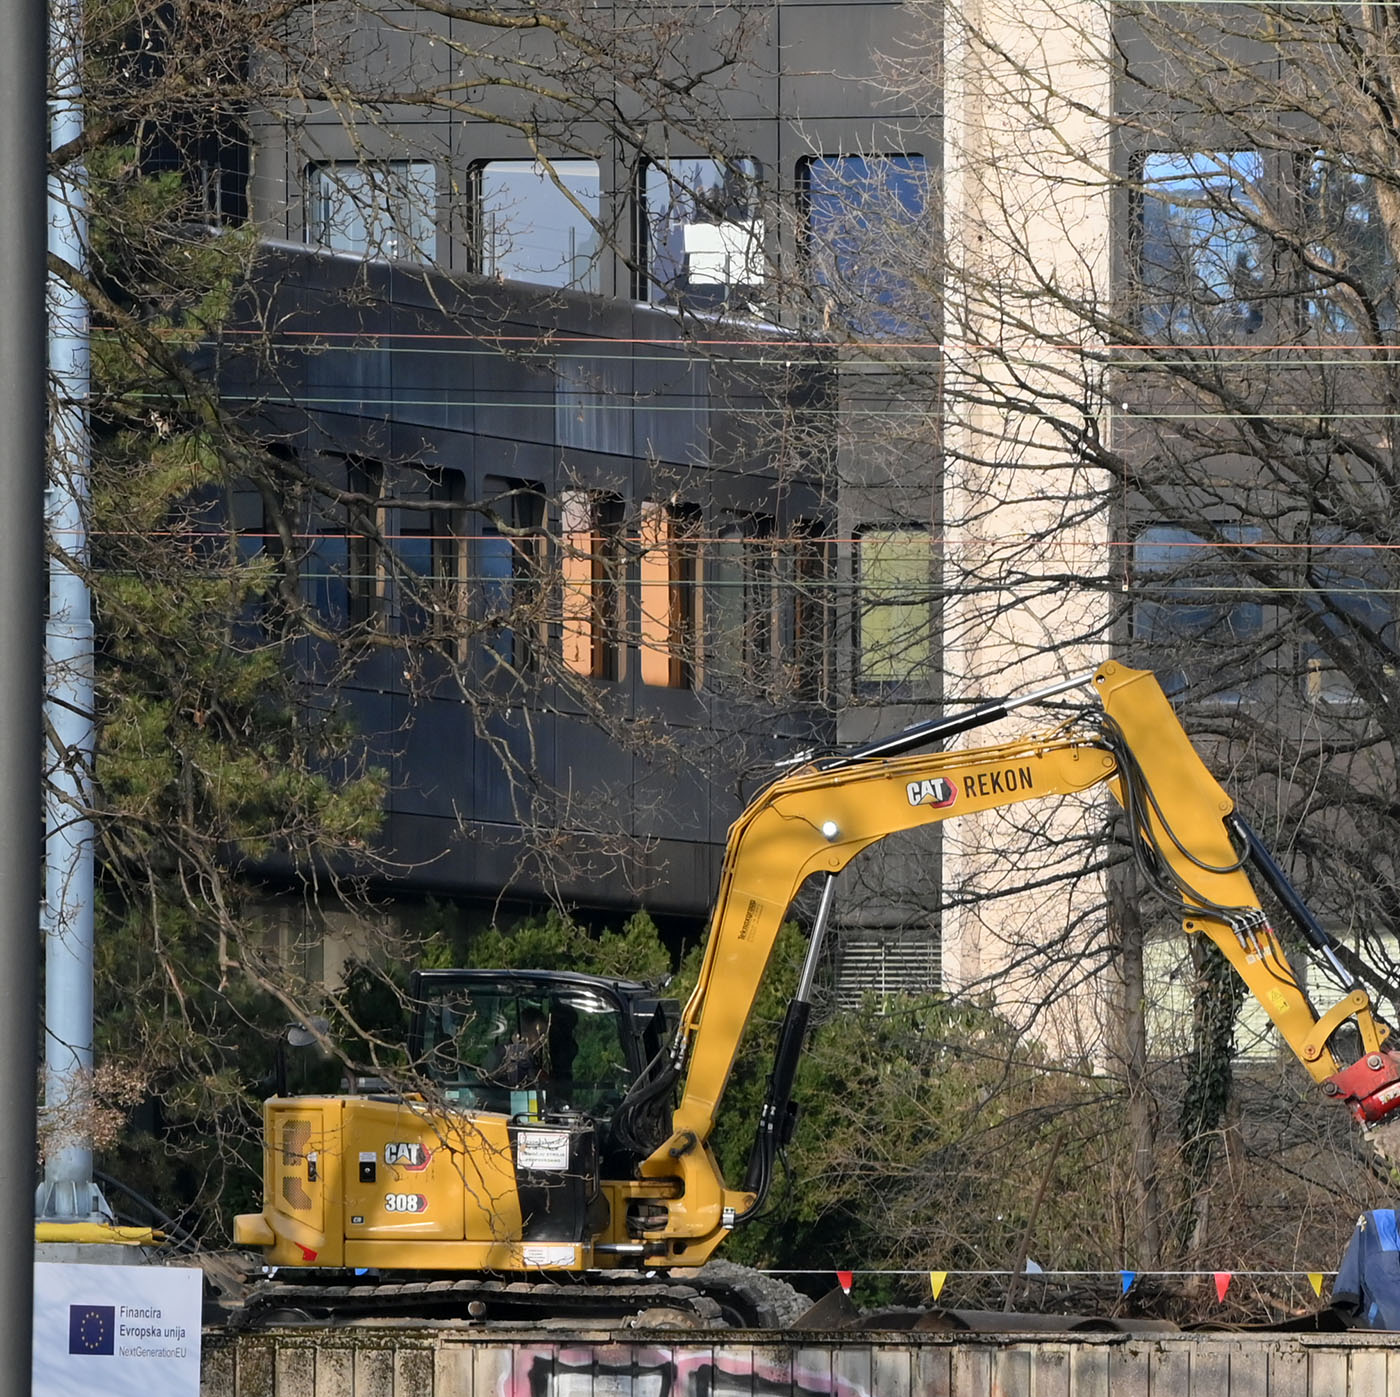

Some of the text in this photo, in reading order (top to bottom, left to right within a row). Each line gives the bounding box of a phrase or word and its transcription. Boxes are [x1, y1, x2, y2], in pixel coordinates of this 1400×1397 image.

[906, 766, 1033, 806] CAT REKON
[385, 1143, 420, 1165] CAT
[385, 1193, 418, 1212] 308
[120, 1306, 161, 1319] Financira
[119, 1325, 186, 1341] Evropska unija
[119, 1346, 187, 1358] NextGenerationEU
